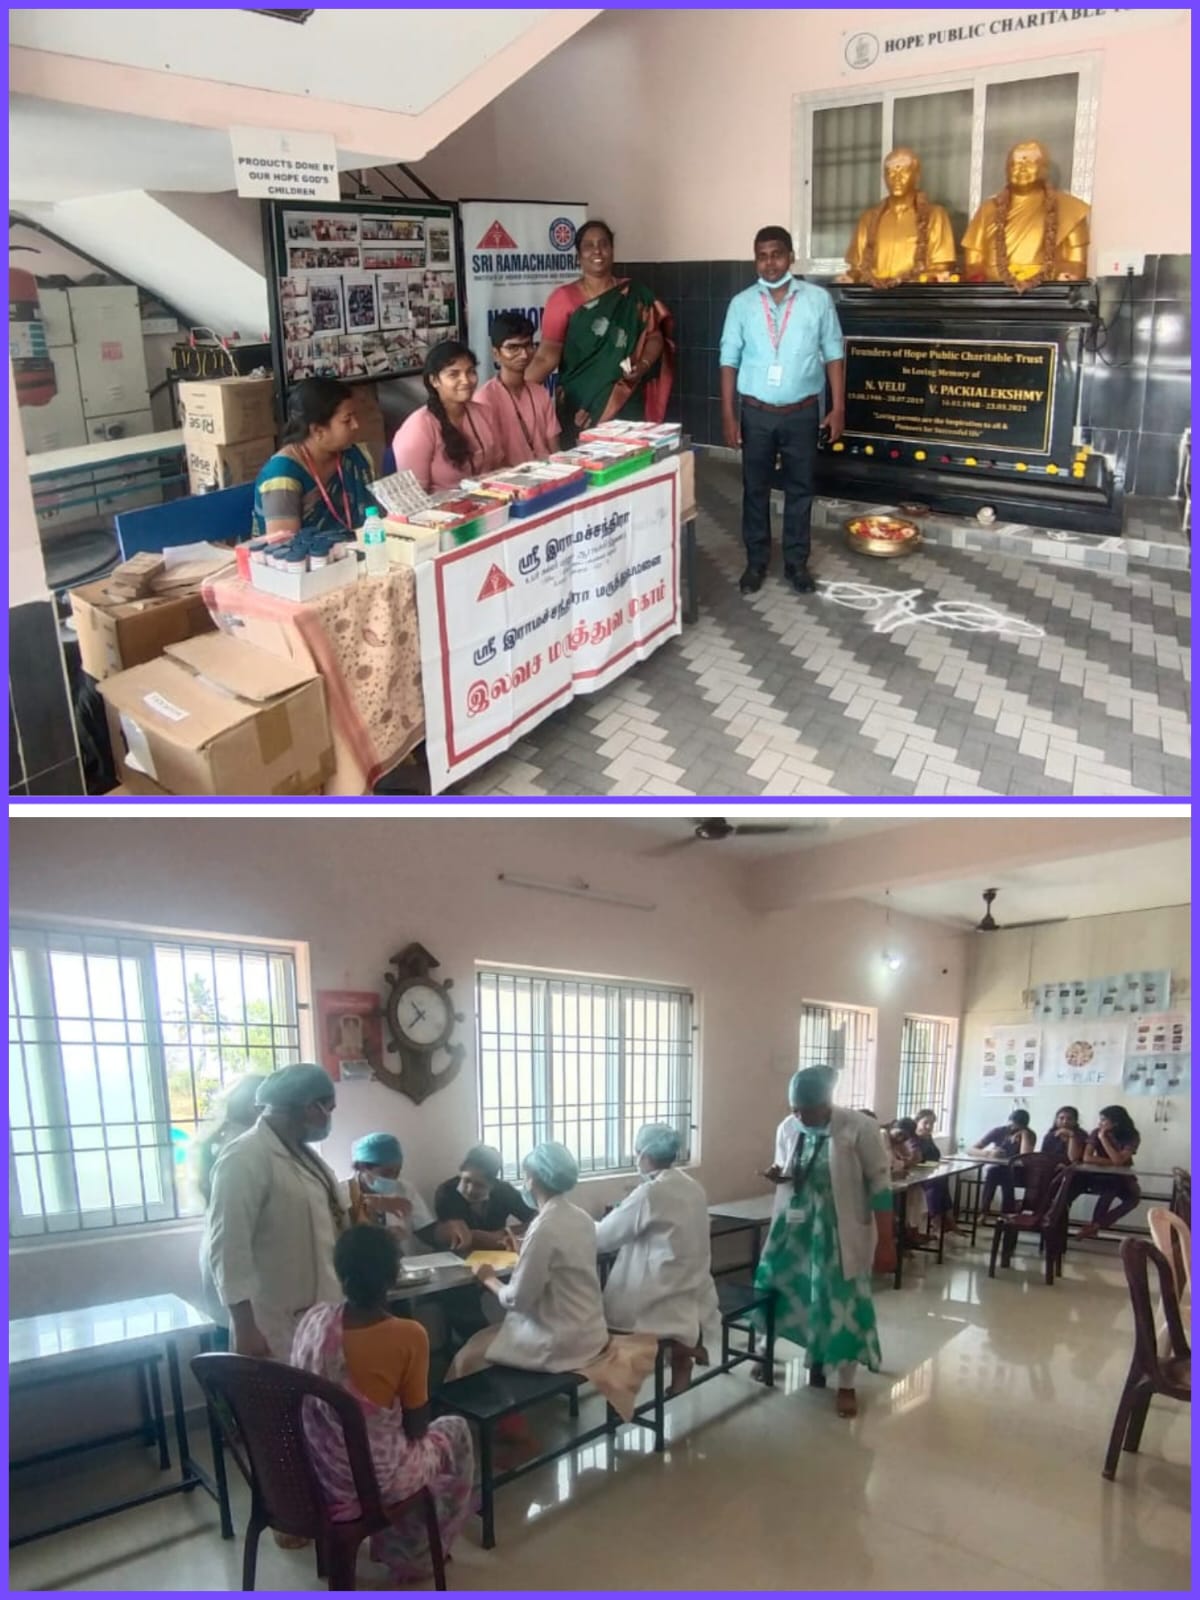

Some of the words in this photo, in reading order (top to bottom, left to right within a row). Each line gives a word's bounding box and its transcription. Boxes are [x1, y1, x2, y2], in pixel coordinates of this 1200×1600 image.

[884, 33, 925, 53] HOPE
[927, 22, 986, 46] PUBLIC
[238, 157, 293, 169] PRODUCTS
[295, 161, 321, 171] DONE
[249, 171, 271, 180] OUR
[273, 173, 300, 182] HOPE
[301, 175, 329, 184] GOD'S
[268, 186, 316, 196] CHILDREN
[472, 254, 493, 273] SRI
[496, 253, 580, 272] RAMACHANDRA
[851, 347, 892, 358] Founders
[892, 347, 903, 358] of
[903, 349, 928, 360] Hope
[929, 350, 960, 360] Public
[961, 352, 1014, 363] Charitable
[1015, 353, 1044, 364] Trust
[902, 366, 911, 374] In
[911, 367, 937, 377] Loving
[938, 368, 970, 379] Memory
[971, 370, 980, 378] of
[865, 380, 877, 390] N.
[878, 380, 907, 392] VELU
[928, 384, 938, 394] V.
[940, 385, 1044, 401] PACKIALEKSHMY
[467, 653, 542, 718] இலவச
